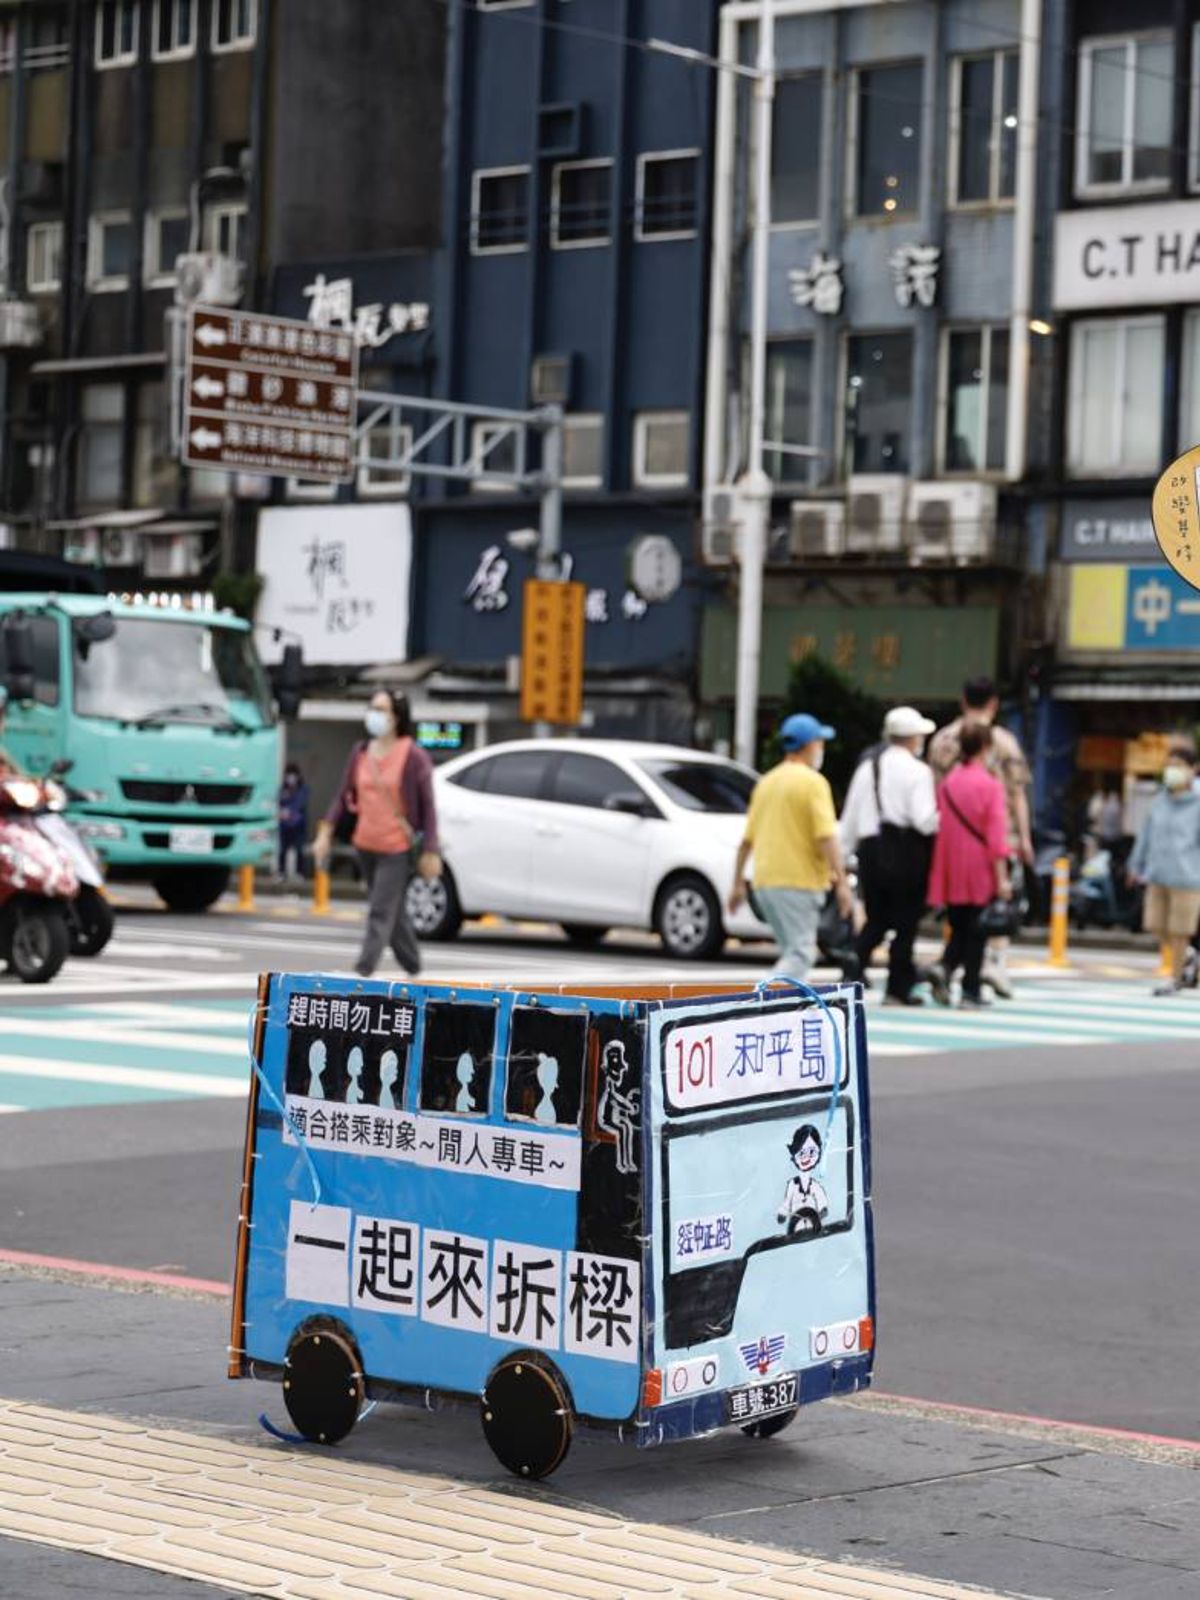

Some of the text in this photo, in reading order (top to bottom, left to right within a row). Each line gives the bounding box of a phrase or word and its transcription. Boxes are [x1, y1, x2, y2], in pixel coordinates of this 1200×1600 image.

[1082, 237, 1143, 278] C.T
[287, 995, 414, 1037] 趕時間勿上車
[675, 1018, 826, 1093] 101 和平島
[677, 1217, 732, 1256] 經中正路
[293, 1220, 634, 1348] 一起來拆樑
